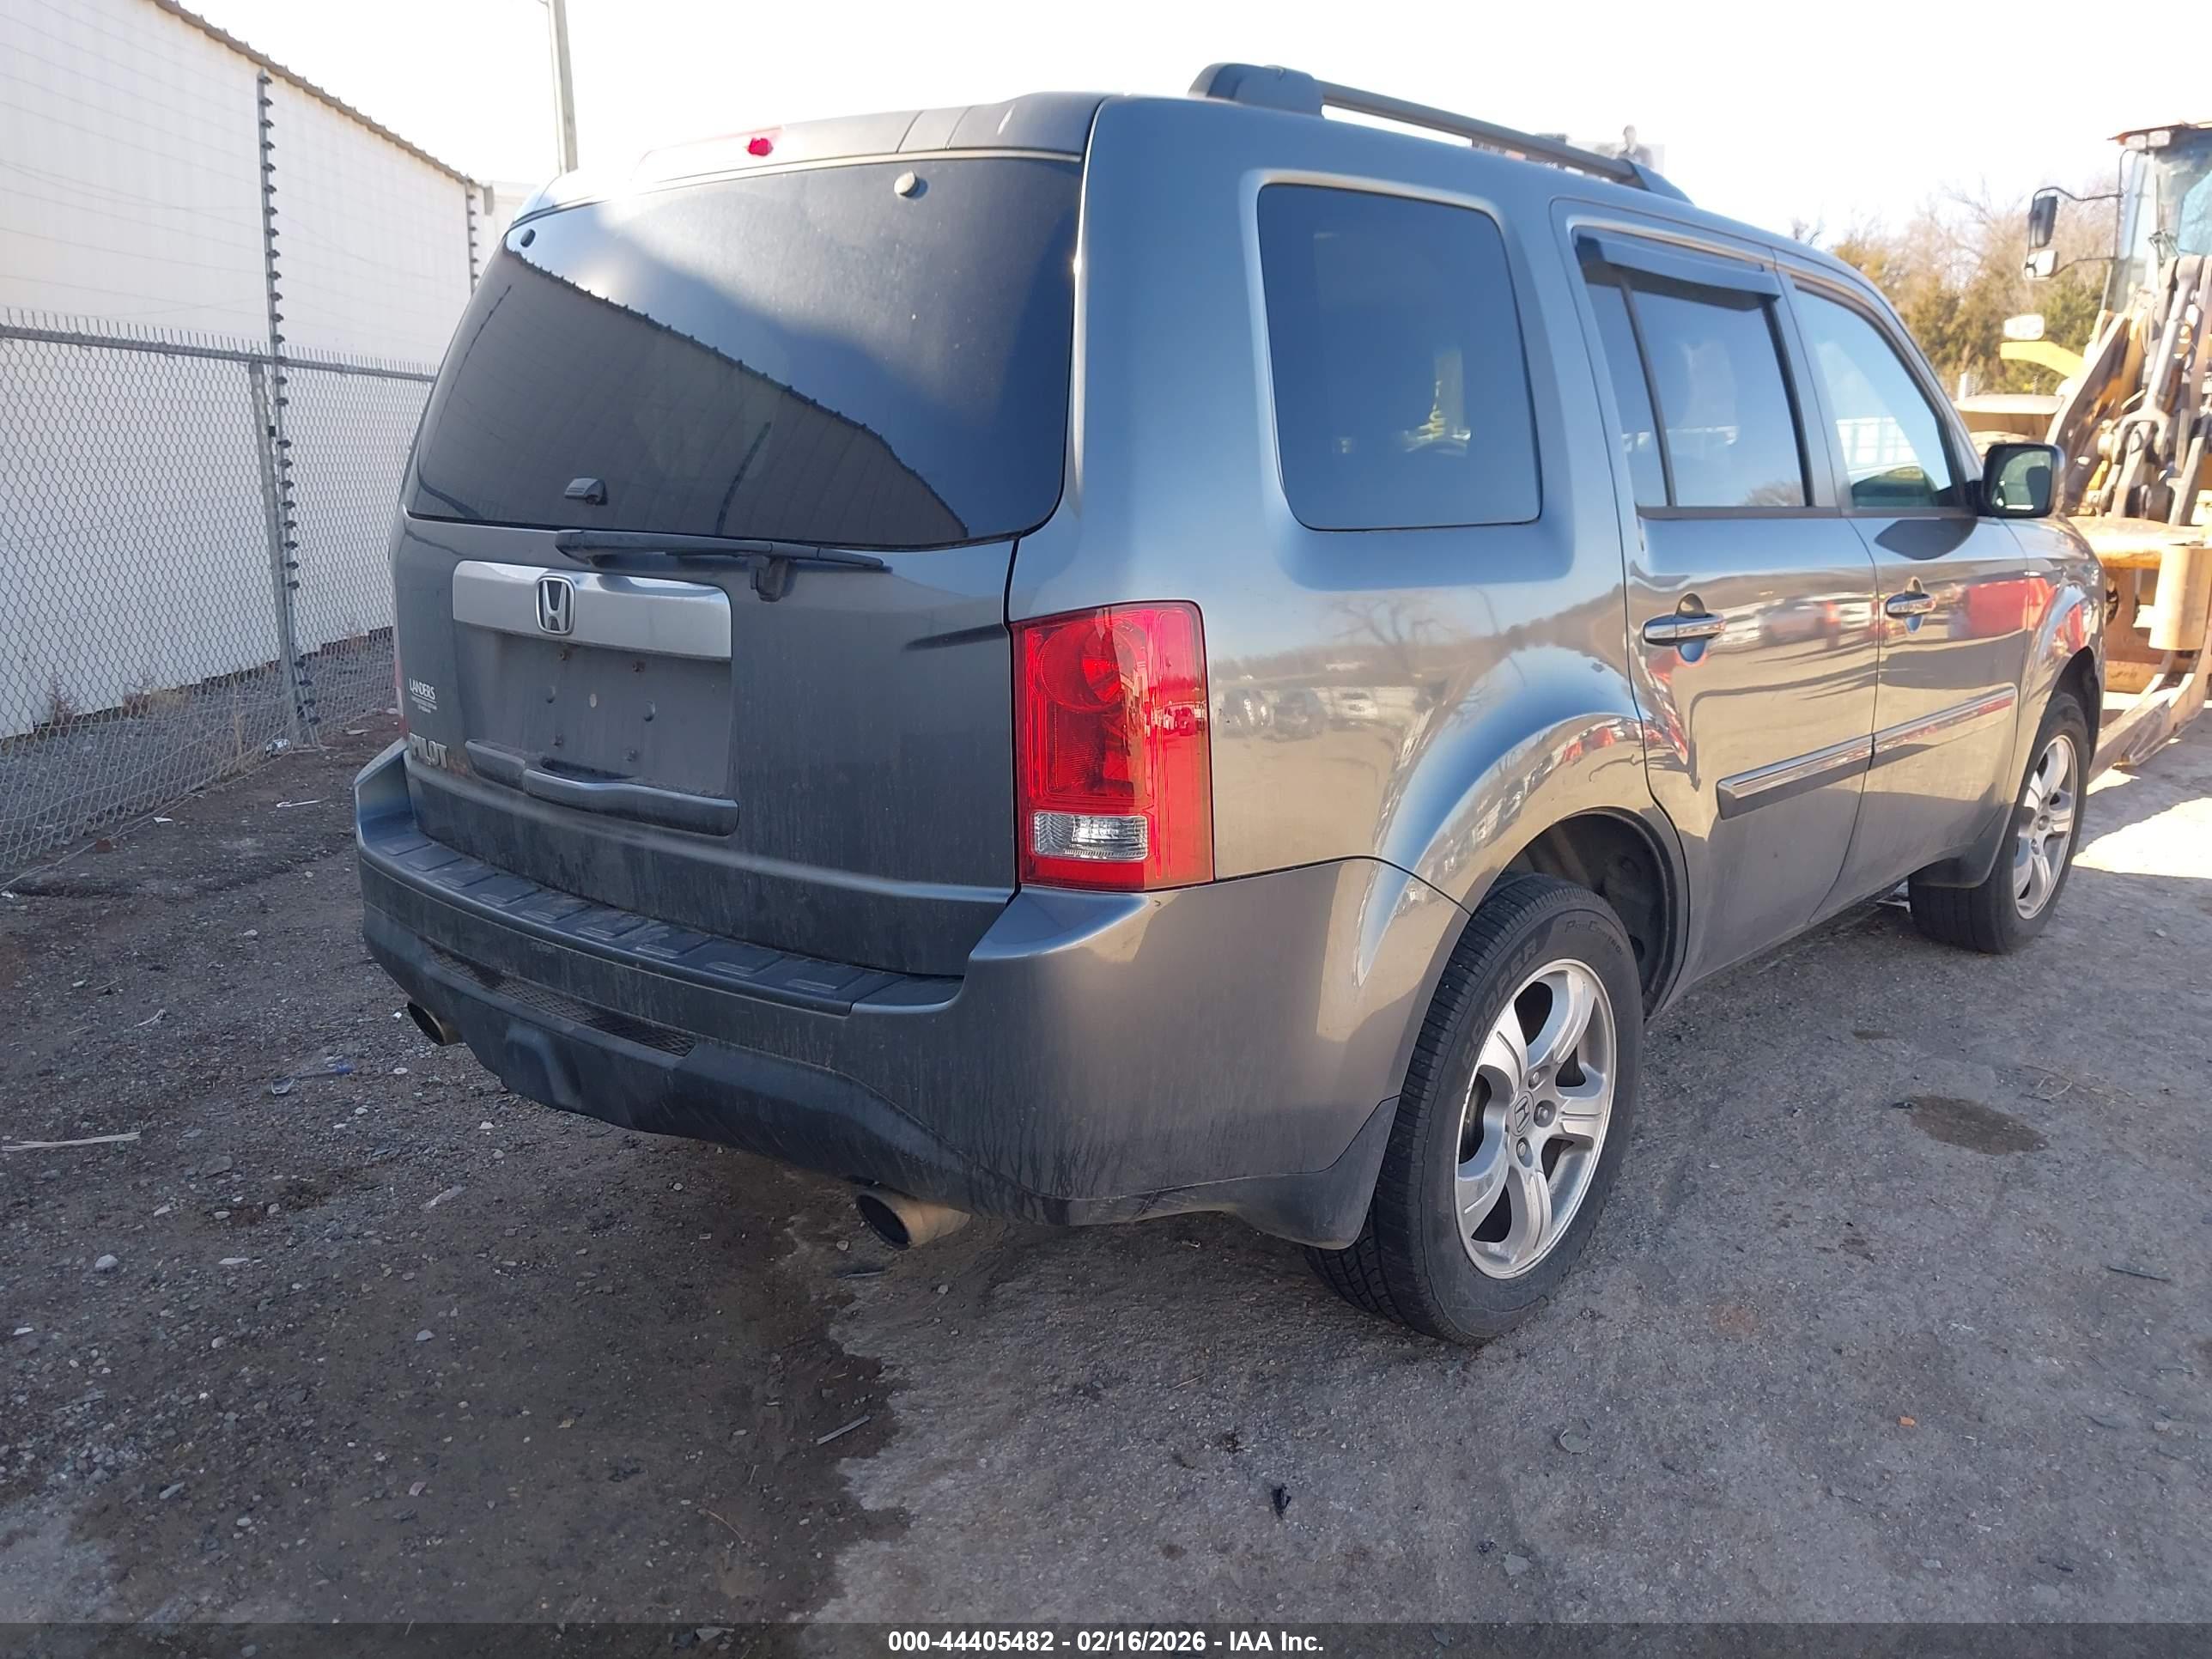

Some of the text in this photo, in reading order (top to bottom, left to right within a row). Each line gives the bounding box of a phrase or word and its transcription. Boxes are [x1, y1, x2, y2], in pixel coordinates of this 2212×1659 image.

[408, 677, 436, 701] LANDERS
[408, 731, 447, 769] PILOT
[1462, 938, 1538, 1070] COOPER
